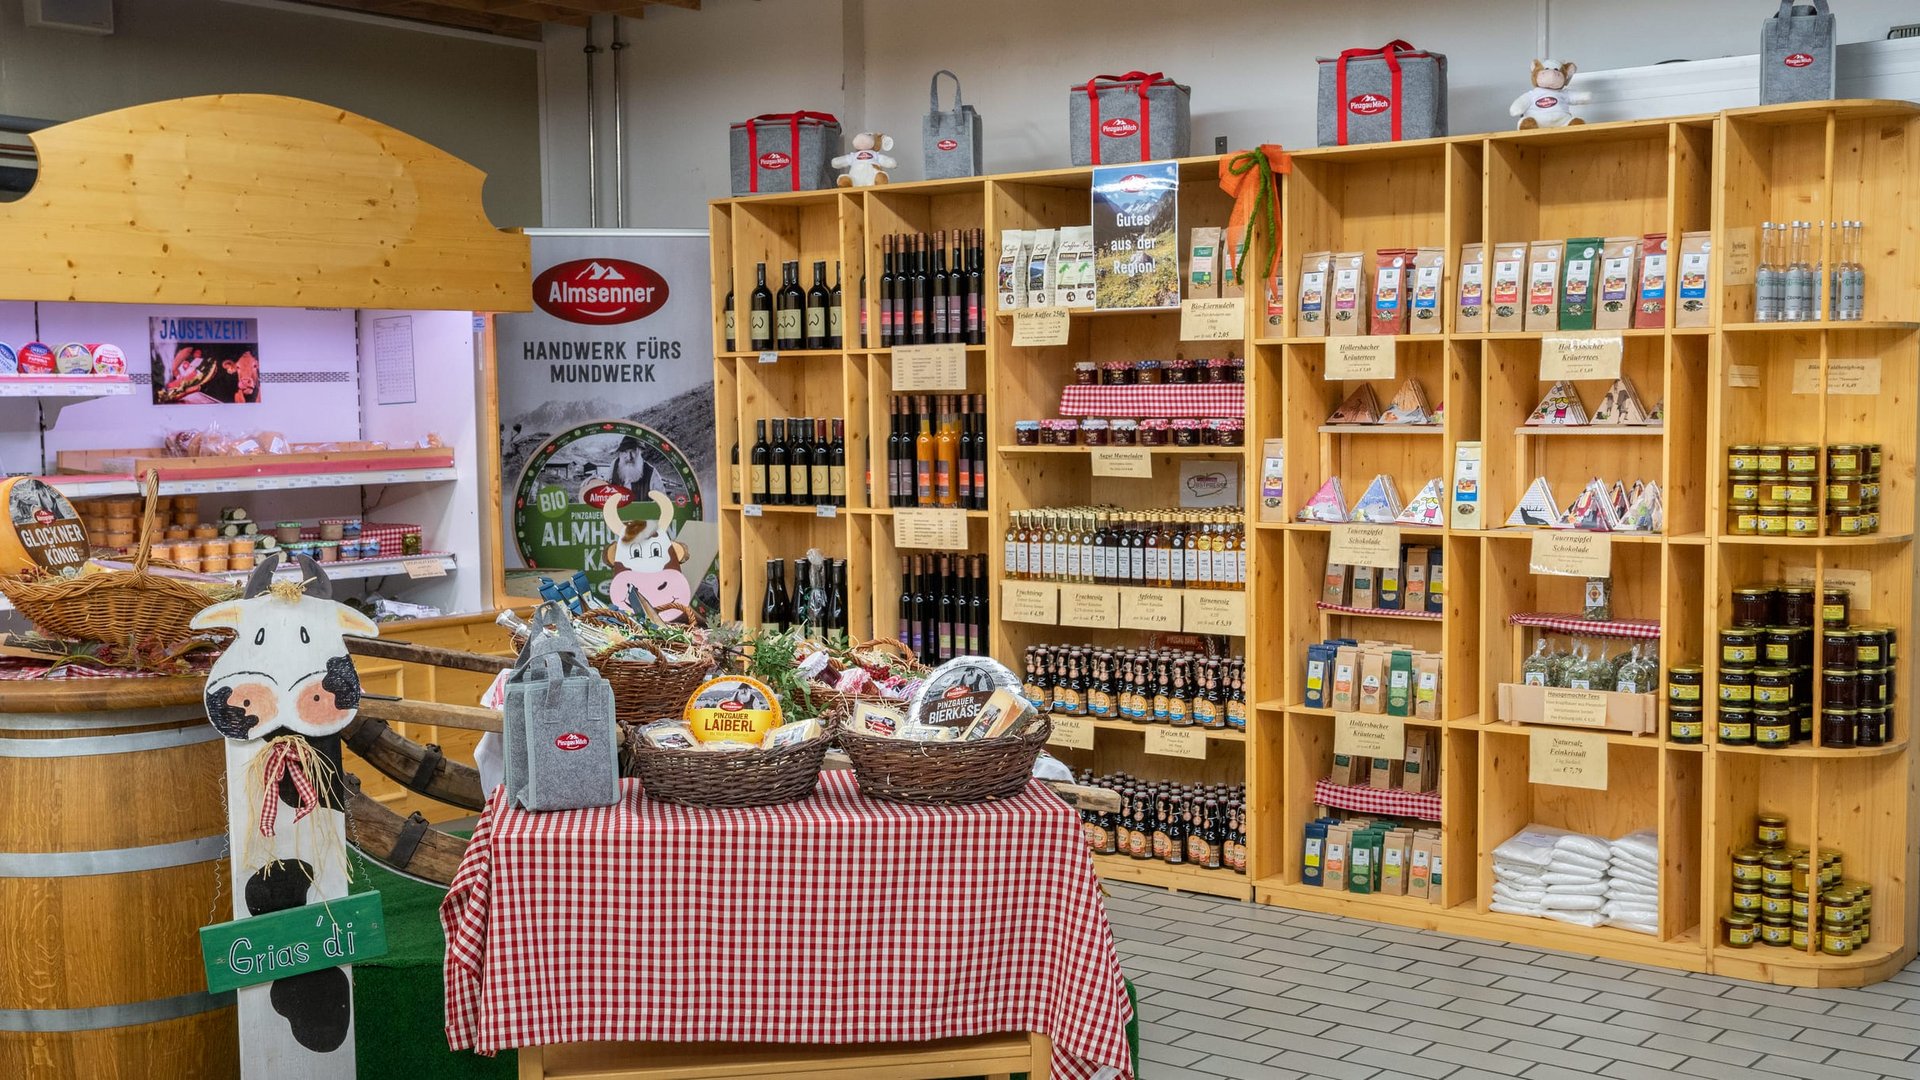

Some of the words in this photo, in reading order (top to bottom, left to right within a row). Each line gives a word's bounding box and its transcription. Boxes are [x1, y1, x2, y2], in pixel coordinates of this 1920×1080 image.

[1350, 101, 1372, 110] Pinzgau
[1372, 100, 1389, 108] Milch
[1102, 124, 1122, 133] Pinzgau
[1122, 123, 1137, 131] Milch
[1116, 213, 1150, 227] Gutes
[1111, 239, 1132, 251] aus
[1137, 234, 1157, 250] der
[1113, 259, 1156, 277] Region!
[549, 280, 655, 303] Almsenner
[1035, 311, 1052, 319] Kaffee
[160, 319, 248, 340] JAUSENZEIT!
[523, 341, 626, 360] HANDWERK
[636, 336, 681, 360] FÜRS
[550, 364, 655, 383] MUNDWERK
[539, 490, 567, 513] BIO
[20, 524, 84, 548] GLOCKNER
[1347, 527, 1384, 536] Tauerngipfel
[1348, 537, 1381, 545] Schokolade
[1552, 534, 1593, 543] Tauerngipfel
[1552, 544, 1590, 553] Schokolade
[44, 545, 80, 566] KÖNIG
[1138, 593, 1163, 601] Apfelessig
[1199, 597, 1230, 605] Birnenessig
[936, 696, 975, 710] PINZGAUER
[713, 712, 749, 720] PINZGAUER
[928, 703, 982, 725] BIERKÄSE
[704, 719, 756, 732] LAIBERL
[1349, 719, 1389, 730] Hollersbacher
[1160, 729, 1178, 737] Weizen
[1353, 730, 1385, 740] Kräutersalz
[557, 739, 576, 747] Pinzgau
[575, 737, 588, 745] Milch
[1553, 738, 1583, 747] Natursalz
[1550, 748, 1587, 758] Feinkristall
[229, 938, 310, 975] Grias
